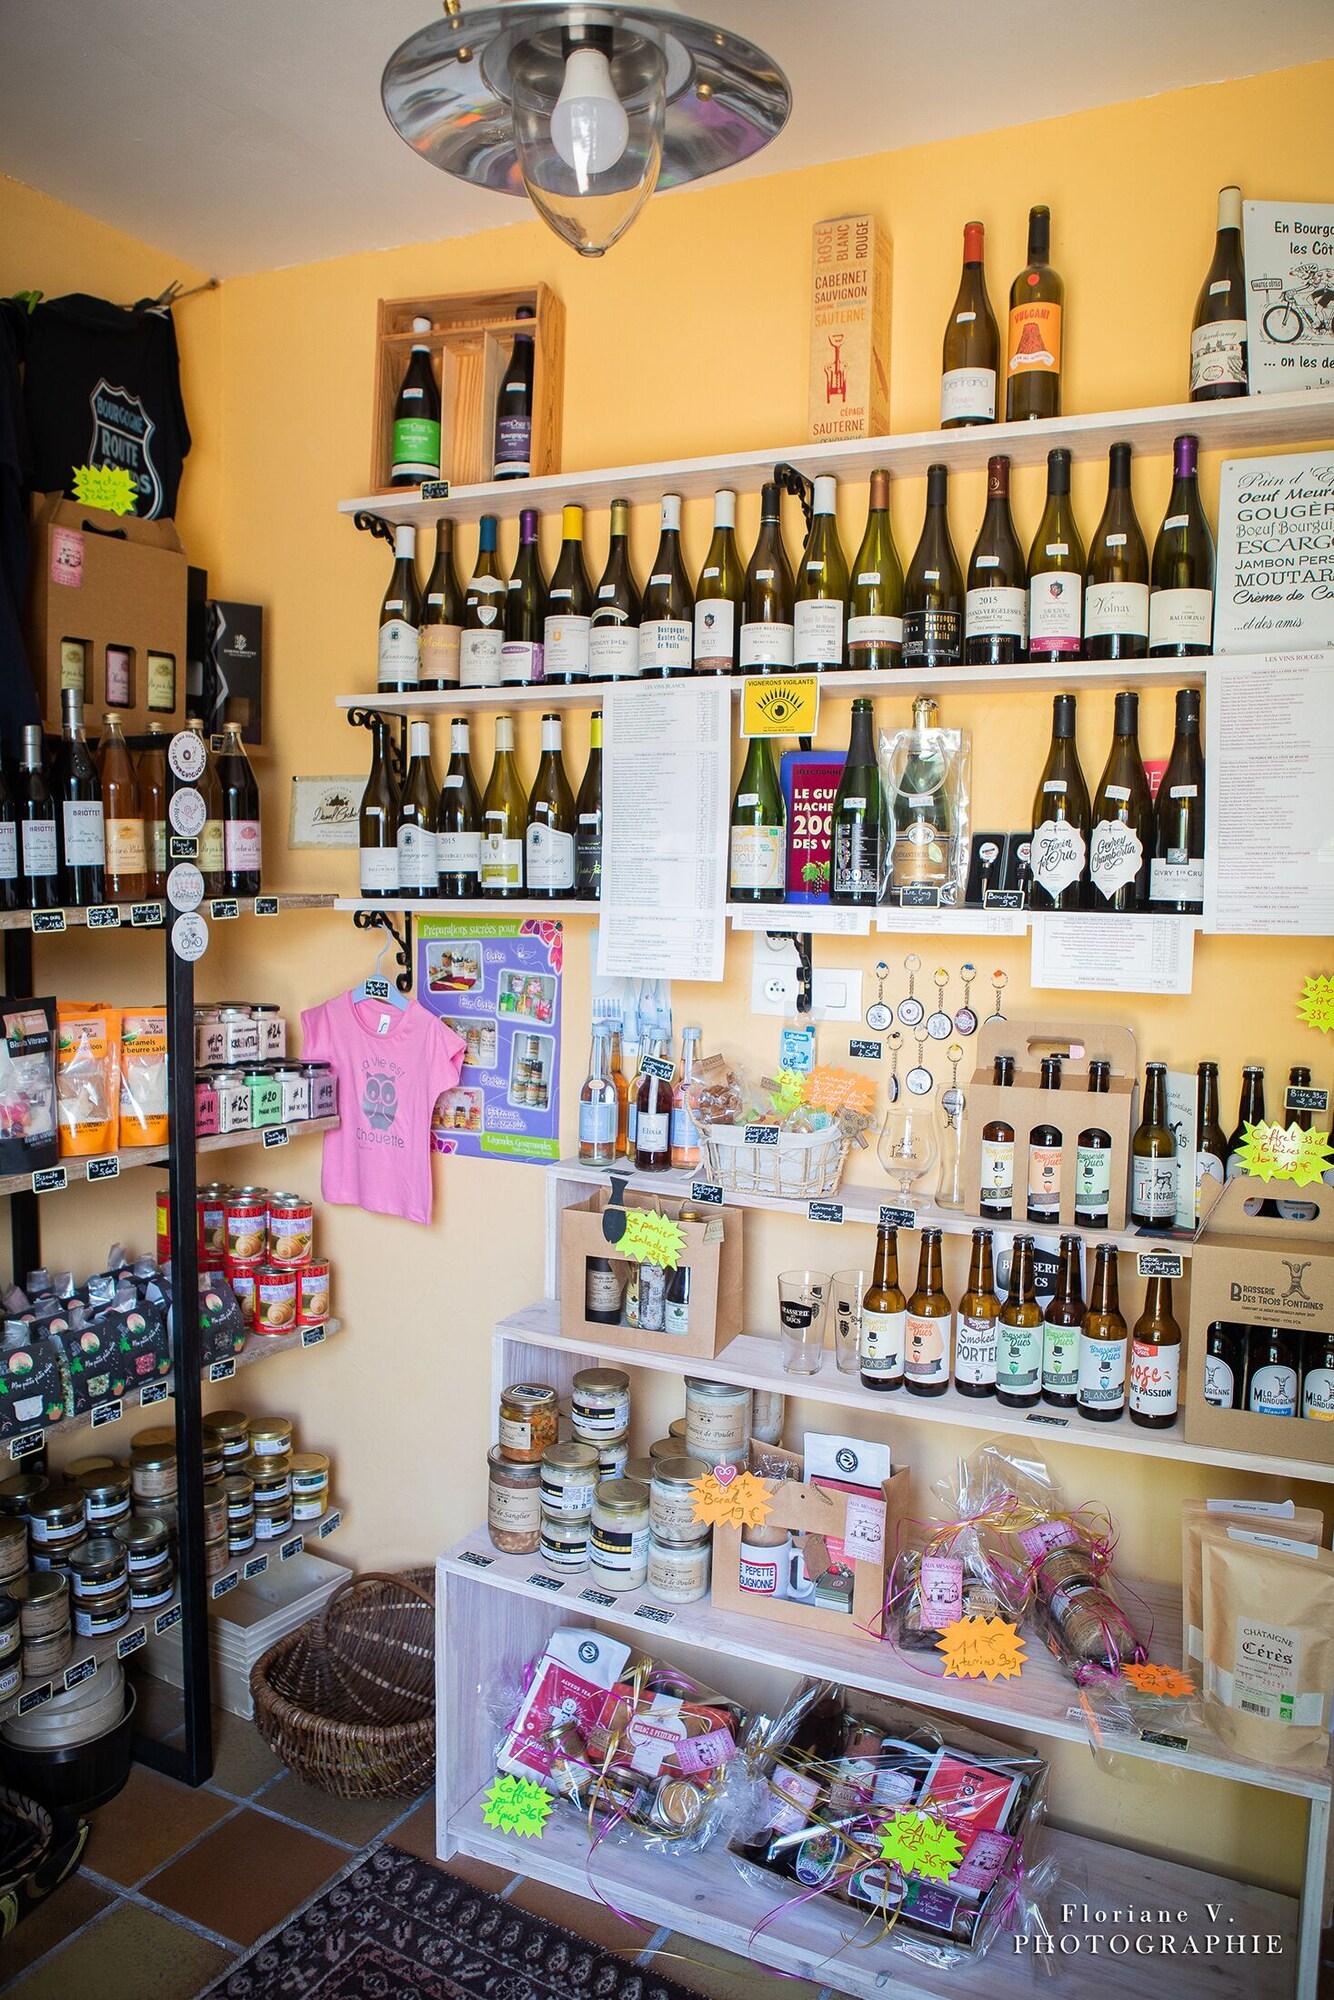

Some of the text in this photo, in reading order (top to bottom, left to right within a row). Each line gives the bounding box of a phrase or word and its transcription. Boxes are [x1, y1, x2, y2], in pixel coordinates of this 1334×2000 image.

[1274, 221, 1289, 233] En
[815, 226, 832, 264] ROSÉ
[837, 224, 849, 261] BLANC
[856, 221, 868, 259] ROUGE
[1290, 242, 1307, 255] les
[815, 270, 867, 290] CABERNET
[815, 288, 867, 304] SAUVIGNON
[815, 309, 865, 327] SAUTERNE
[1281, 357, 1294, 368] on
[1300, 355, 1318, 368] les
[97, 396, 143, 433] BOURGOGNE
[840, 406, 864, 417] CÉPAGE
[813, 418, 864, 436] SAUTERNE
[102, 429, 138, 466] ROUTE
[1237, 471, 1284, 488] Pain
[1238, 490, 1280, 503] Oeuf
[1235, 557, 1295, 570] JAMBON
[979, 596, 998, 605] 2015
[1233, 590, 1283, 604] Crème
[1286, 589, 1304, 601] de
[1096, 597, 1130, 616] Volnay
[1255, 616, 1272, 629] des
[1275, 617, 1303, 629] amis
[657, 626, 684, 634] Bourgogne
[748, 678, 814, 687] VIGNERONS VIGILANTS
[794, 789, 809, 799] LE
[72, 809, 100, 817] BRIOTTET
[794, 803, 834, 812] HACHE
[793, 839, 817, 849] DES
[1188, 869, 1203, 877] CRU
[424, 923, 517, 937] Préparations sucrées pour
[27, 1037, 48, 1047] Vitraux
[123, 1038, 155, 1047] Caramels
[152, 1045, 165, 1053] salé
[372, 1056, 387, 1067] vie
[1251, 1128, 1313, 1146] Coffret 33
[1261, 1143, 1269, 1153] 6
[1272, 1145, 1300, 1155] bières
[1084, 1158, 1105, 1167] Ducs
[1231, 1283, 1275, 1301] BRASSERIE
[1259, 1295, 1280, 1306] TROIS
[1282, 1298, 1324, 1312] FONTAINES
[960, 1329, 995, 1344] Smoked
[1002, 1330, 1032, 1339] Brasserie
[1053, 1336, 1074, 1346] Ducs
[1009, 1338, 1031, 1347] Ducs
[1089, 1344, 1121, 1354] Brasserie
[1100, 1351, 1121, 1360] Ducs
[1060, 1375, 1076, 1384] ALE
[1083, 1388, 1122, 1399] BLANCHE
[1139, 1385, 1172, 1398] PASSION
[714, 1430, 735, 1438] Poulet
[505, 1510, 531, 1520] Sanglier
[722, 1506, 760, 1522] 19 €
[745, 1568, 774, 1577] PEPETTE
[1243, 1628, 1294, 1648] CHÂTAIGNE
[1242, 1641, 1293, 1665] Cérès
[561, 1678, 581, 1693] ALVEUS
[499, 1782, 541, 1806] Coffret
